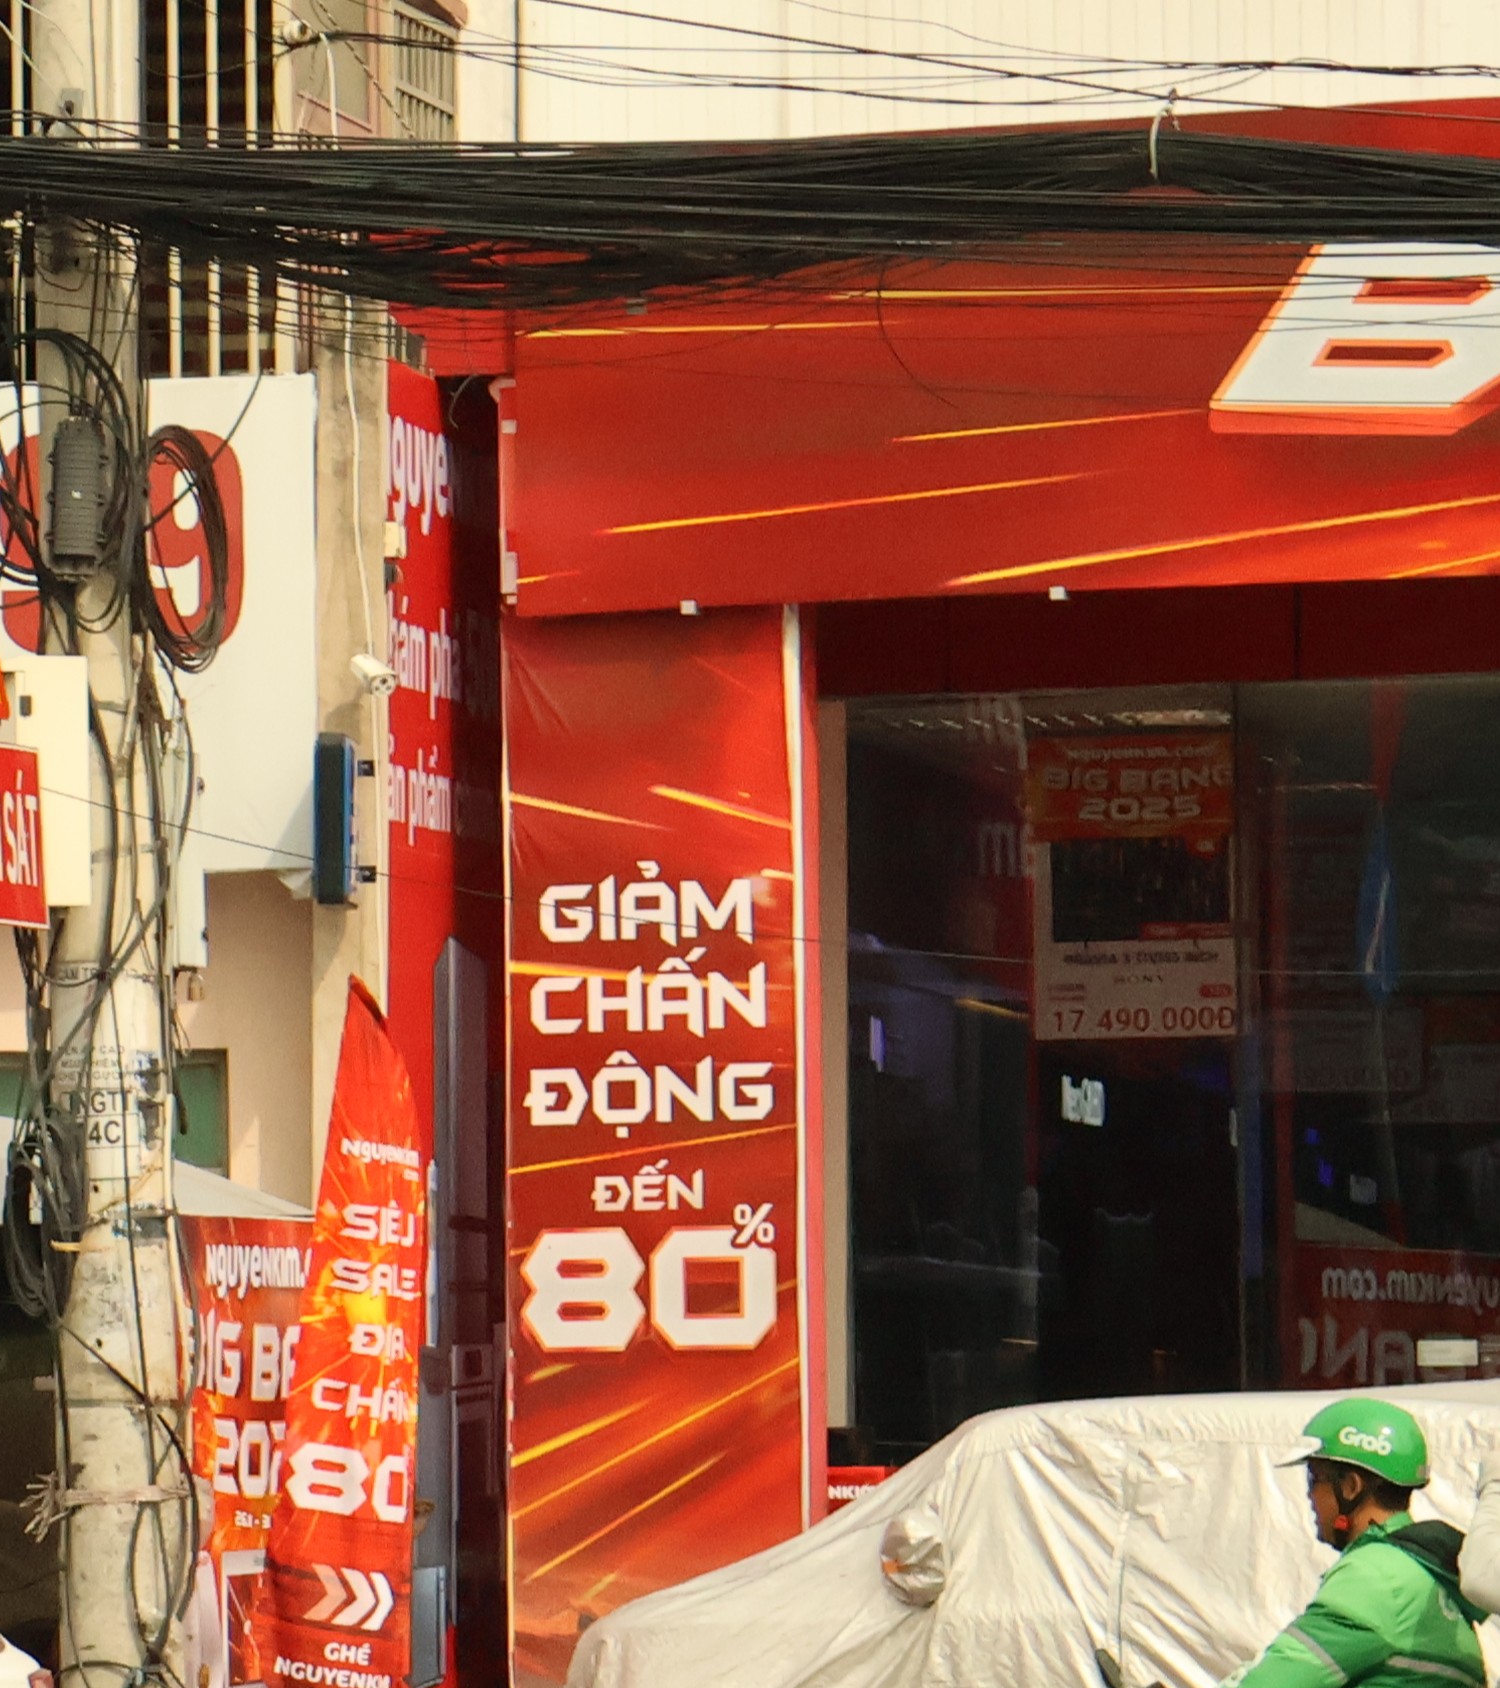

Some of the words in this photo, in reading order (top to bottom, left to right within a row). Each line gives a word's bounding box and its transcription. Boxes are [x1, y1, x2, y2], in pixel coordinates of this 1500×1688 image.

[1042, 767, 1107, 793] BIG
[2, 769, 40, 888] SÁT
[1078, 794, 1201, 821] 2025
[539, 860, 753, 945] GIẢM
[530, 946, 766, 1038] CHẤN
[523, 1051, 775, 1138] ĐỘNG
[591, 1159, 705, 1212] ĐẾN
[1338, 1423, 1392, 1456] Grab
[324, 1642, 371, 1666] GHÉ
